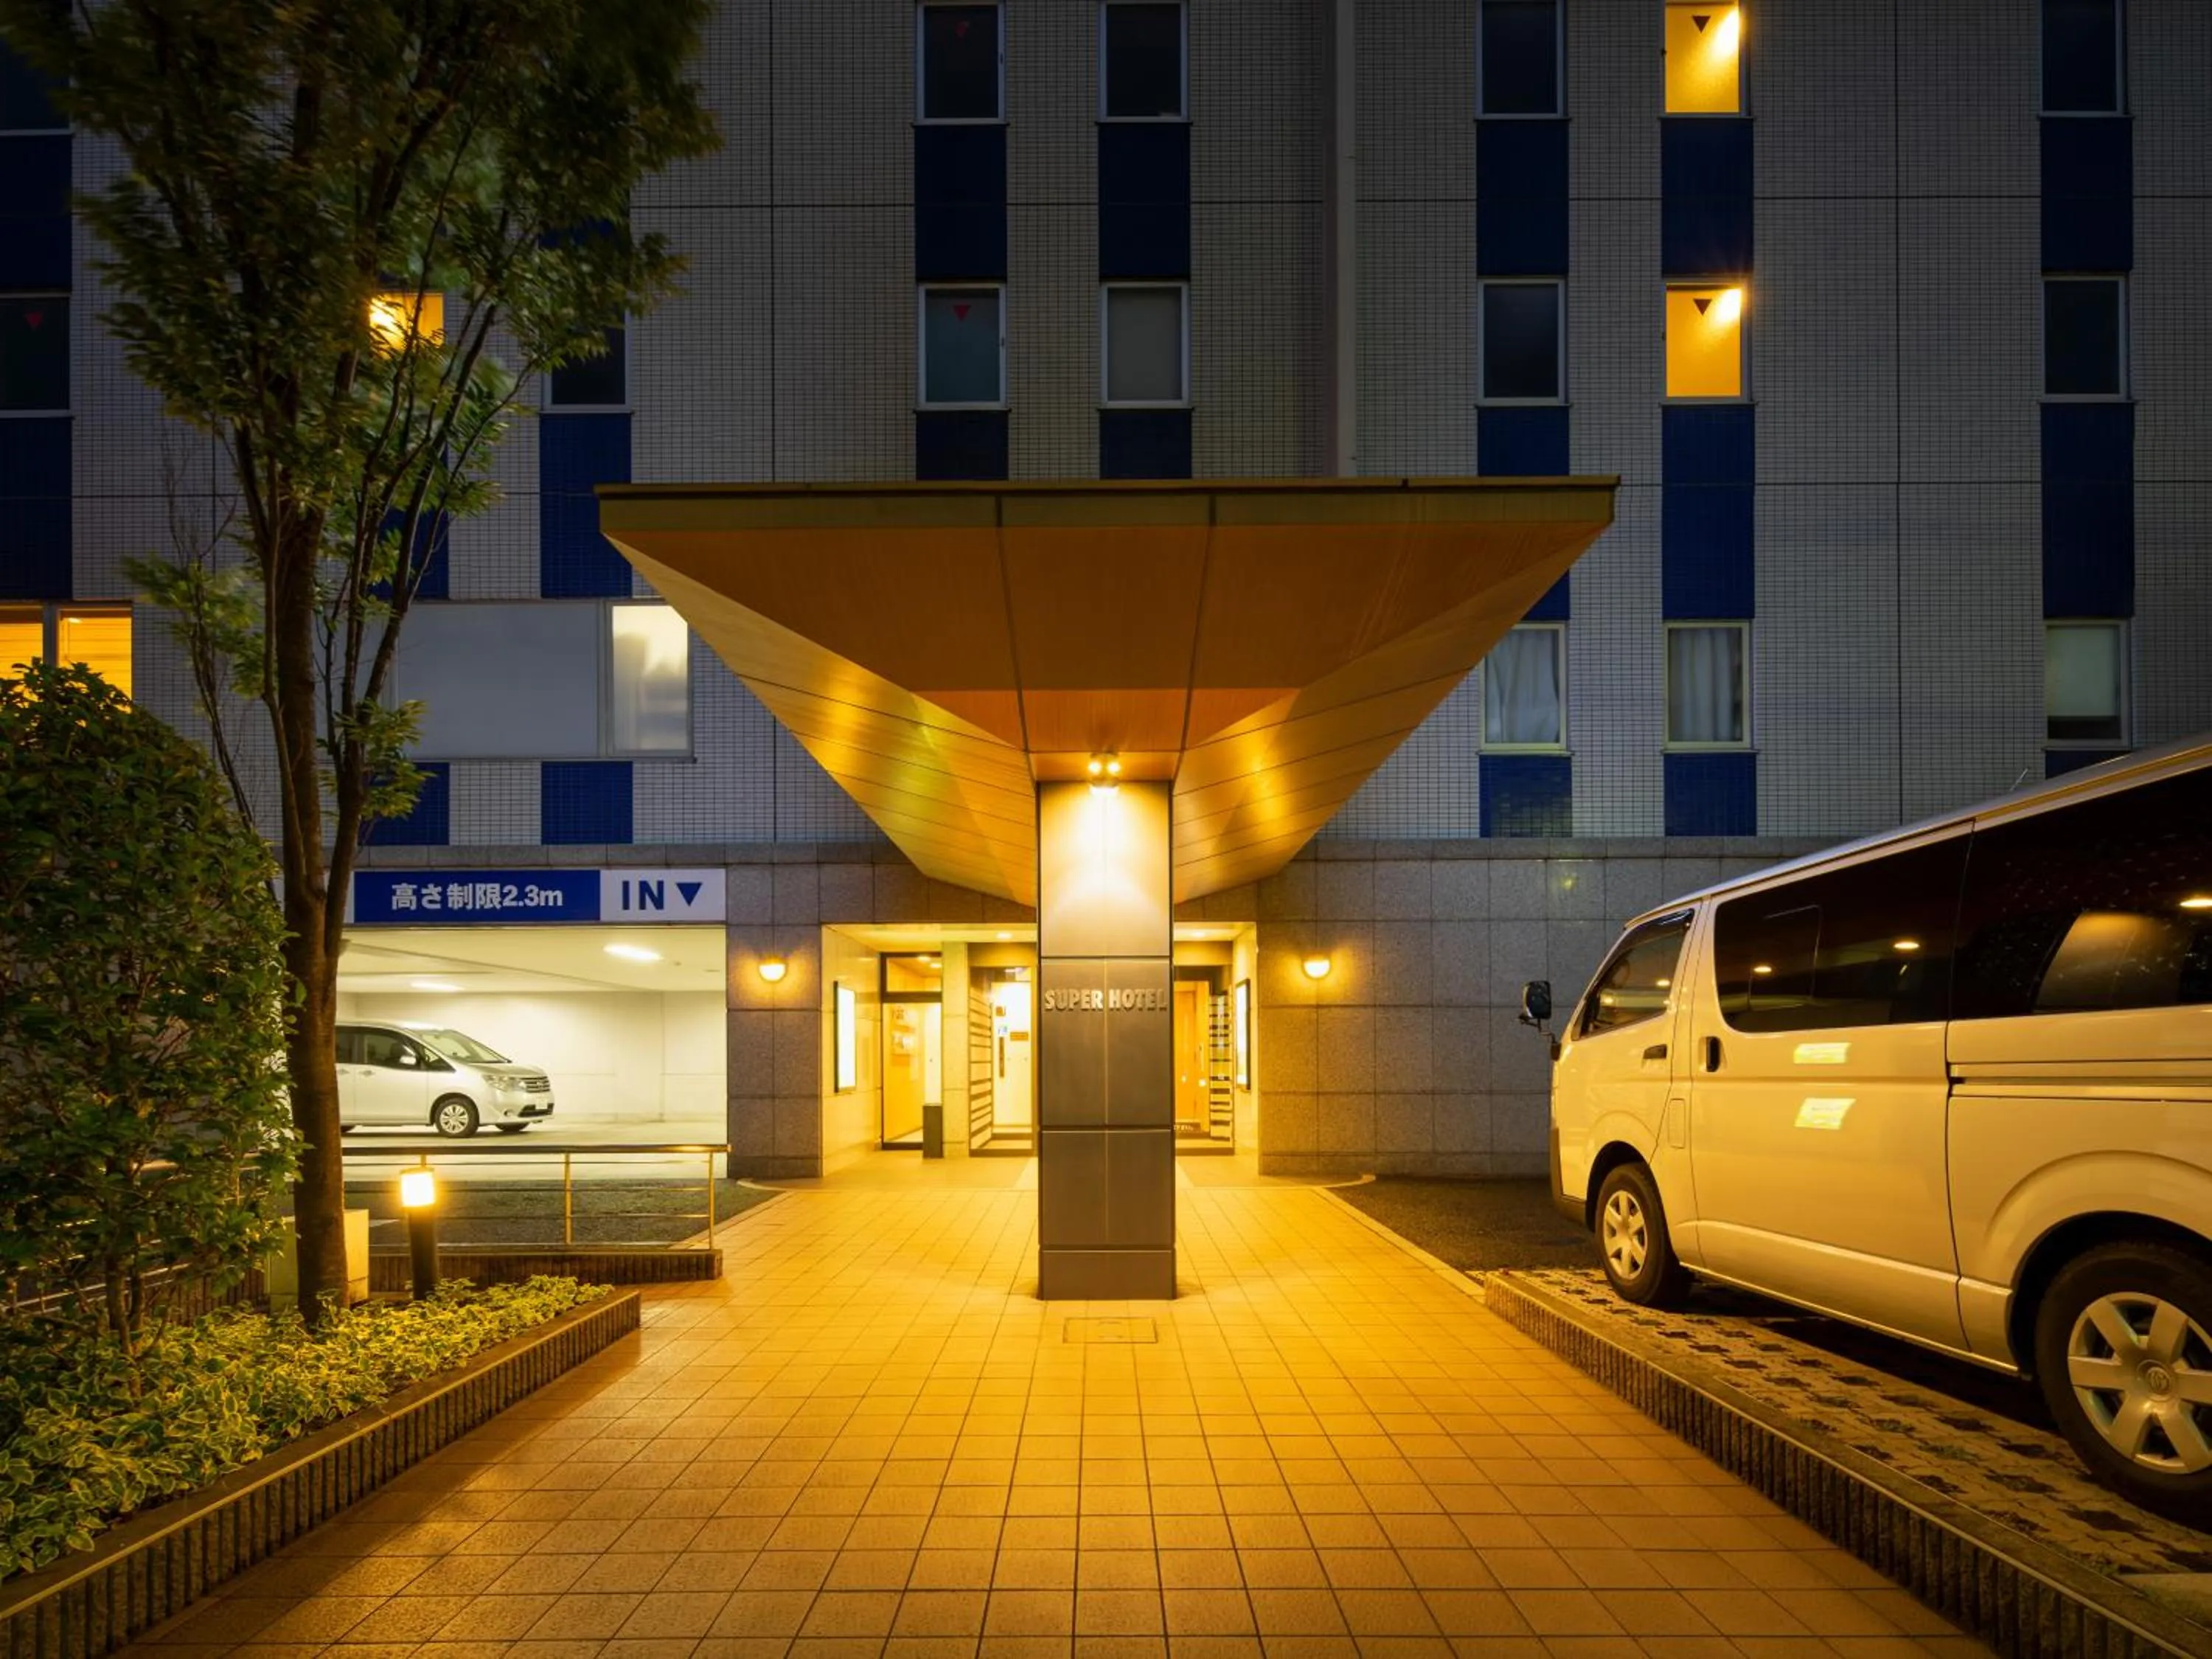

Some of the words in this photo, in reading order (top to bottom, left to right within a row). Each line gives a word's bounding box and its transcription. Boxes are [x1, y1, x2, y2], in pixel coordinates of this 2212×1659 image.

[392, 883, 563, 910] 高さ制限2.3m
[622, 880, 664, 911] IN
[1044, 989, 1104, 1011] SUPER
[1107, 989, 1167, 1011] HOTEL
